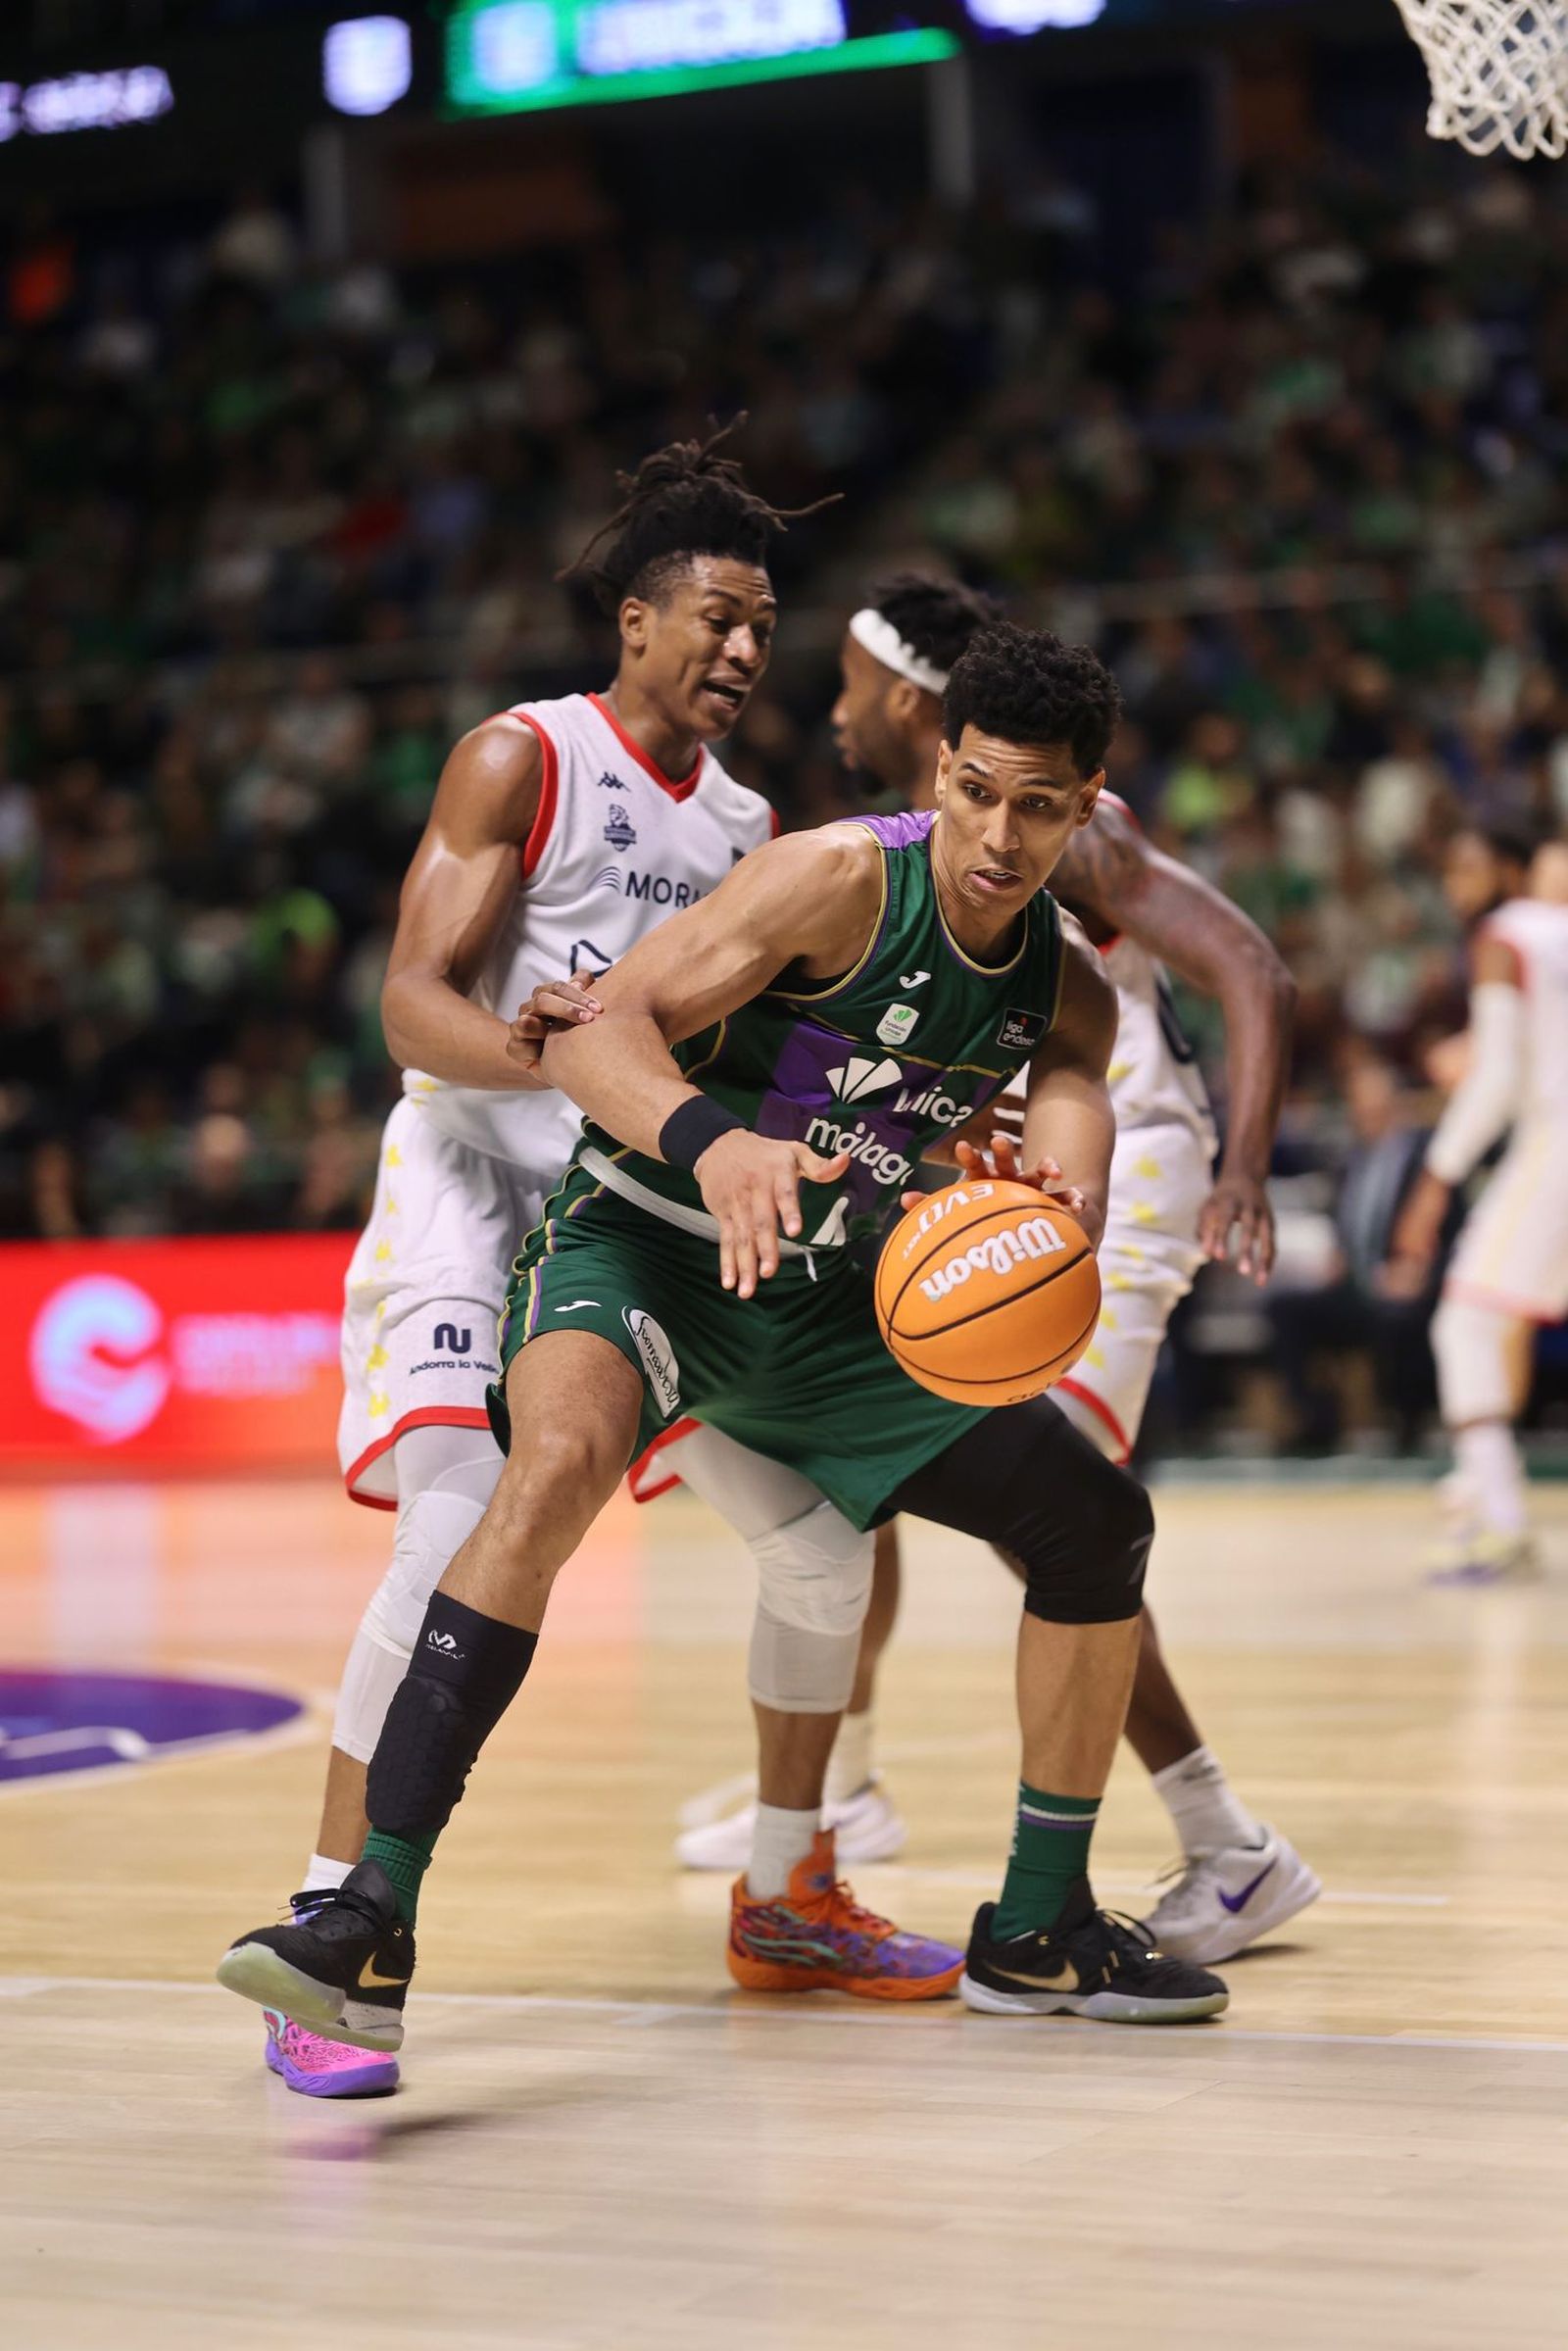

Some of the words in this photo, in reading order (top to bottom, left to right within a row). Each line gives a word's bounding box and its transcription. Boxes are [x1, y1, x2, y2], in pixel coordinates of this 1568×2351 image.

[805, 1117, 914, 1186] málag
[918, 1183, 994, 1234] EVO
[919, 1217, 1066, 1302] Wilson
